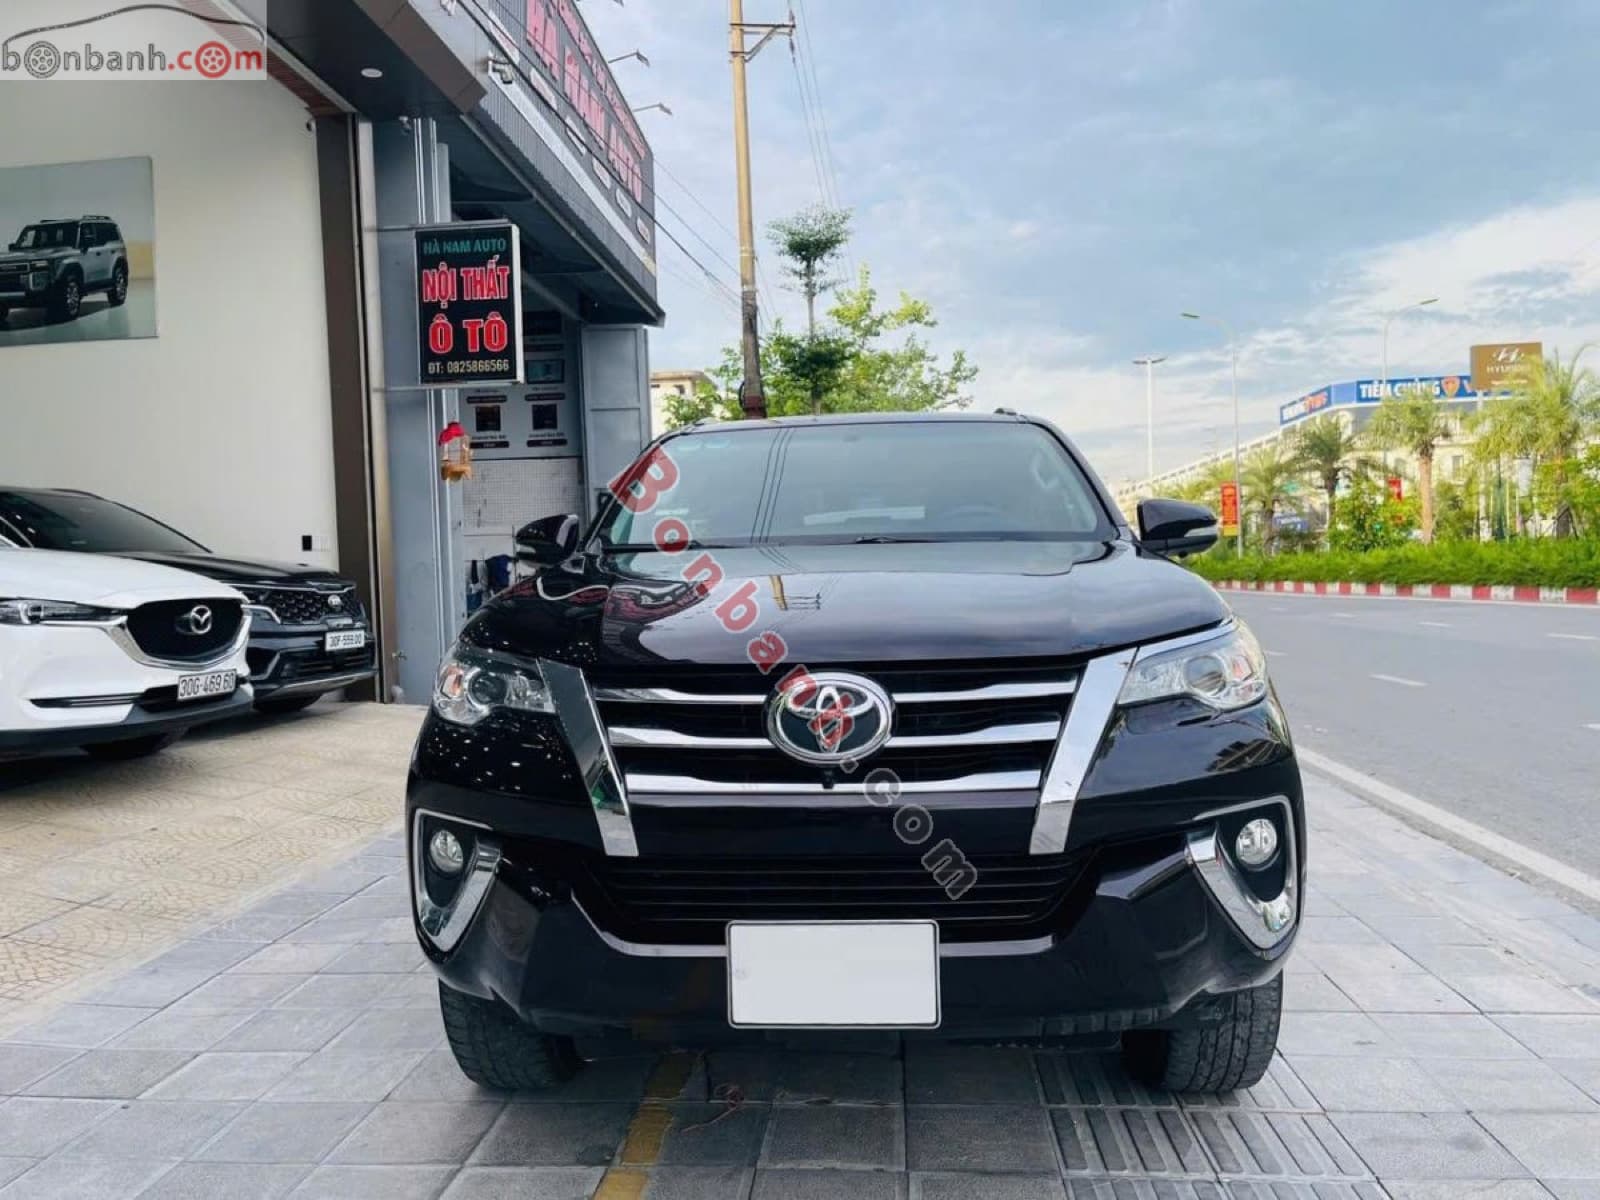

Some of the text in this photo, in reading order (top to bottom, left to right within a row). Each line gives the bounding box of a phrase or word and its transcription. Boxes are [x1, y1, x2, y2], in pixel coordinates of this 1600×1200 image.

[424, 238, 506, 254] HÀ NAM AUTO
[423, 254, 510, 309] NỘI THẤT
[429, 311, 508, 353] Ô TÔ
